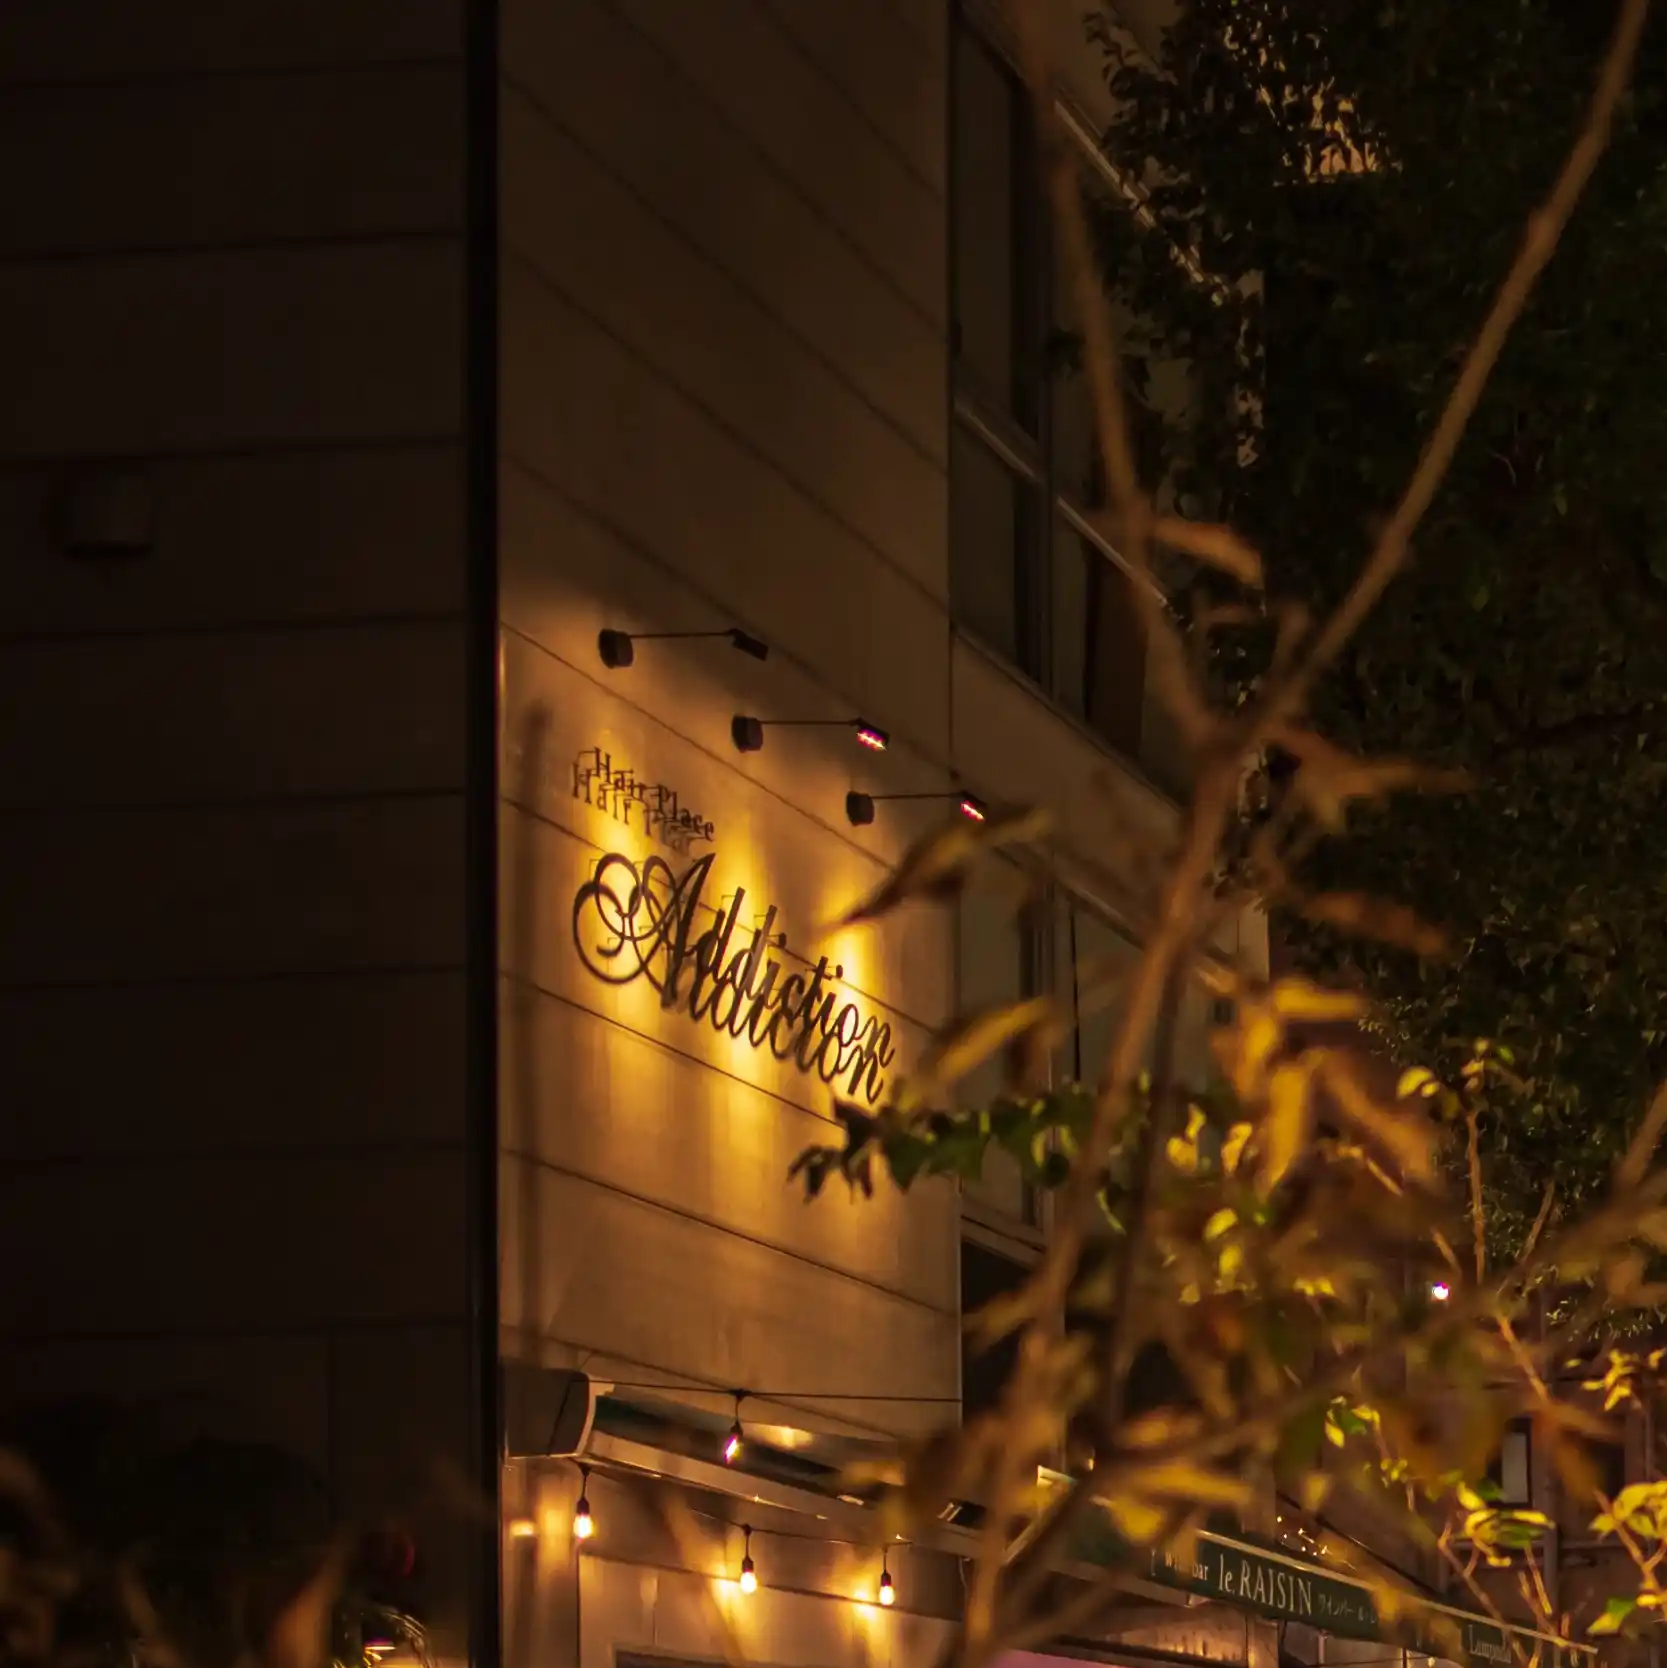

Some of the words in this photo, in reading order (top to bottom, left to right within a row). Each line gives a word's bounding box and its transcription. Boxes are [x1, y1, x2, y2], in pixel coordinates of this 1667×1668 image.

[588, 747, 647, 803] Hair
[583, 853, 895, 1080] Addiction
[1239, 1559, 1313, 1616] RAISIN
